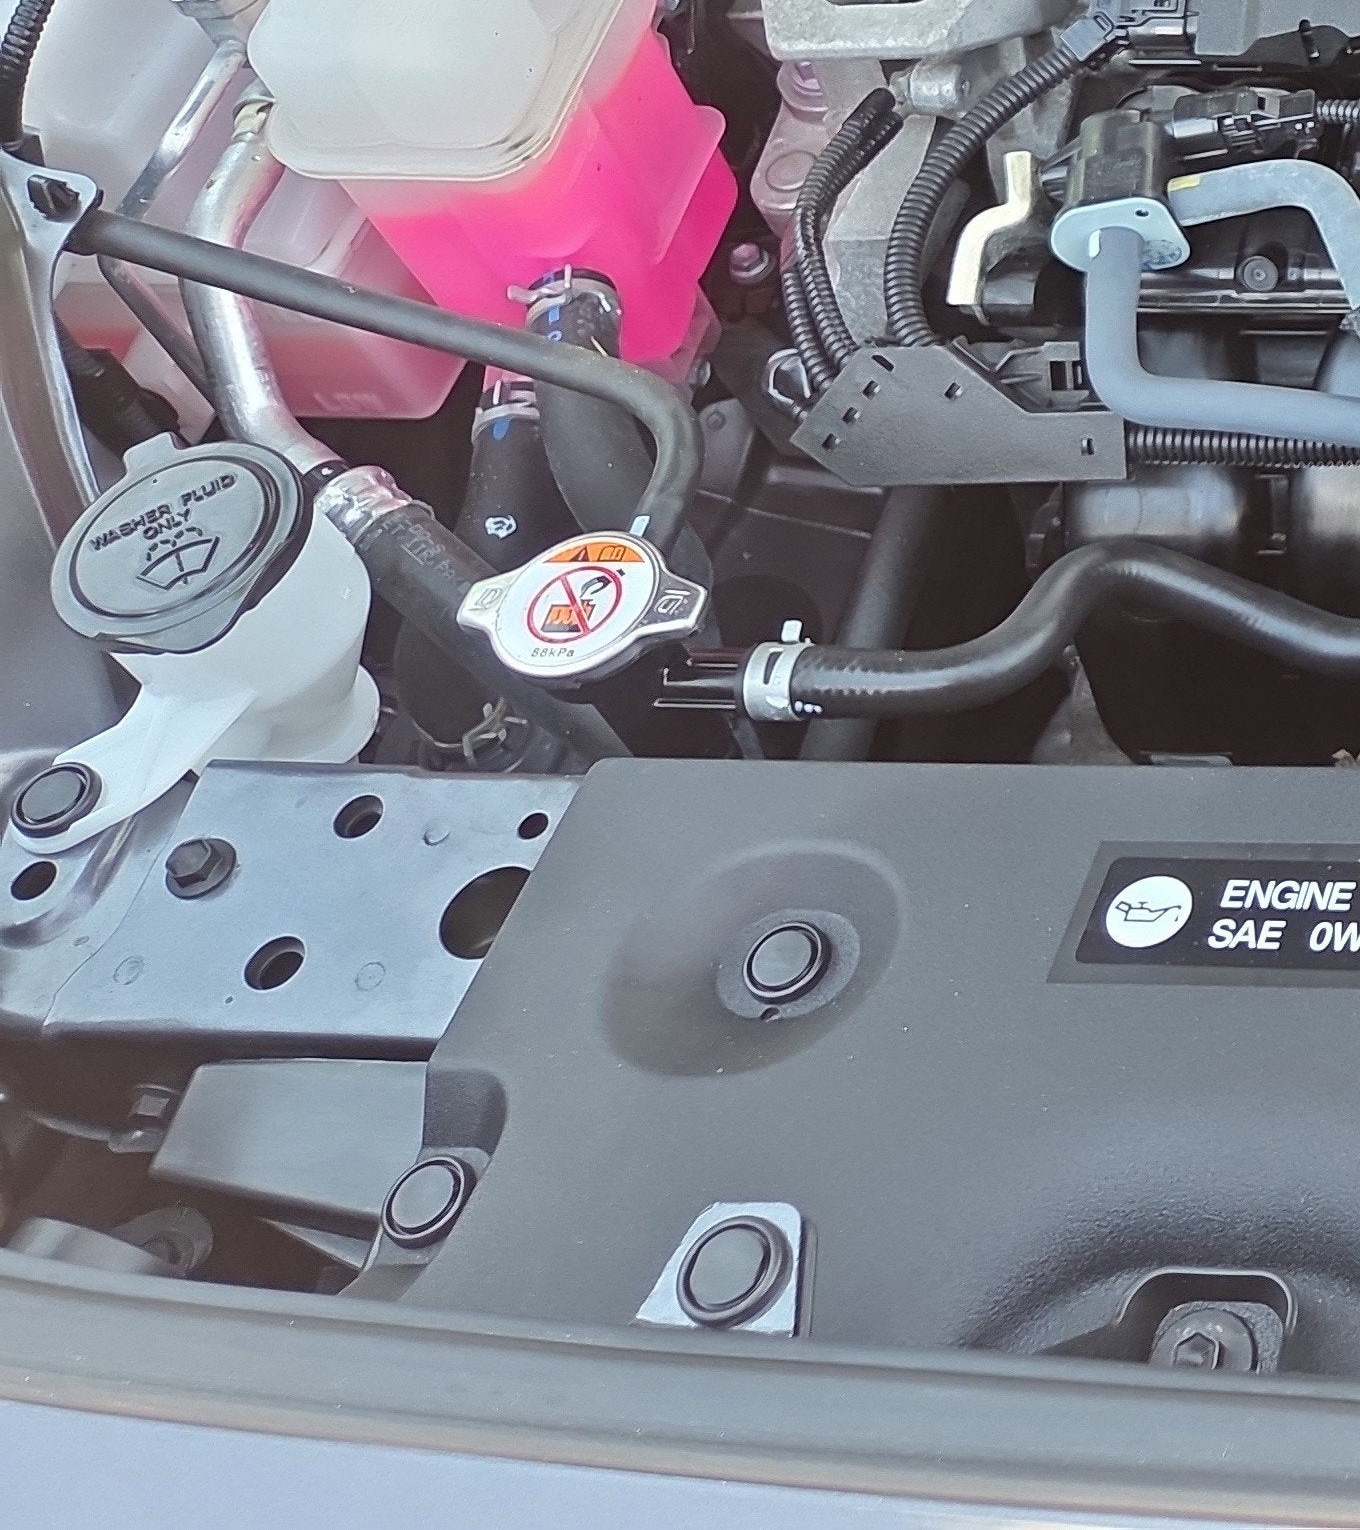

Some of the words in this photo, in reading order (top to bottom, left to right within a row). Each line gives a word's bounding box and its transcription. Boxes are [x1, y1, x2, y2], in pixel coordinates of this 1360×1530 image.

[89, 503, 172, 551] WASHER
[180, 474, 235, 507] FLUID
[142, 507, 190, 540] ONLY
[531, 647, 575, 658] 88kPa
[1219, 879, 1357, 912] ENGINE
[1207, 919, 1286, 950] SAE
